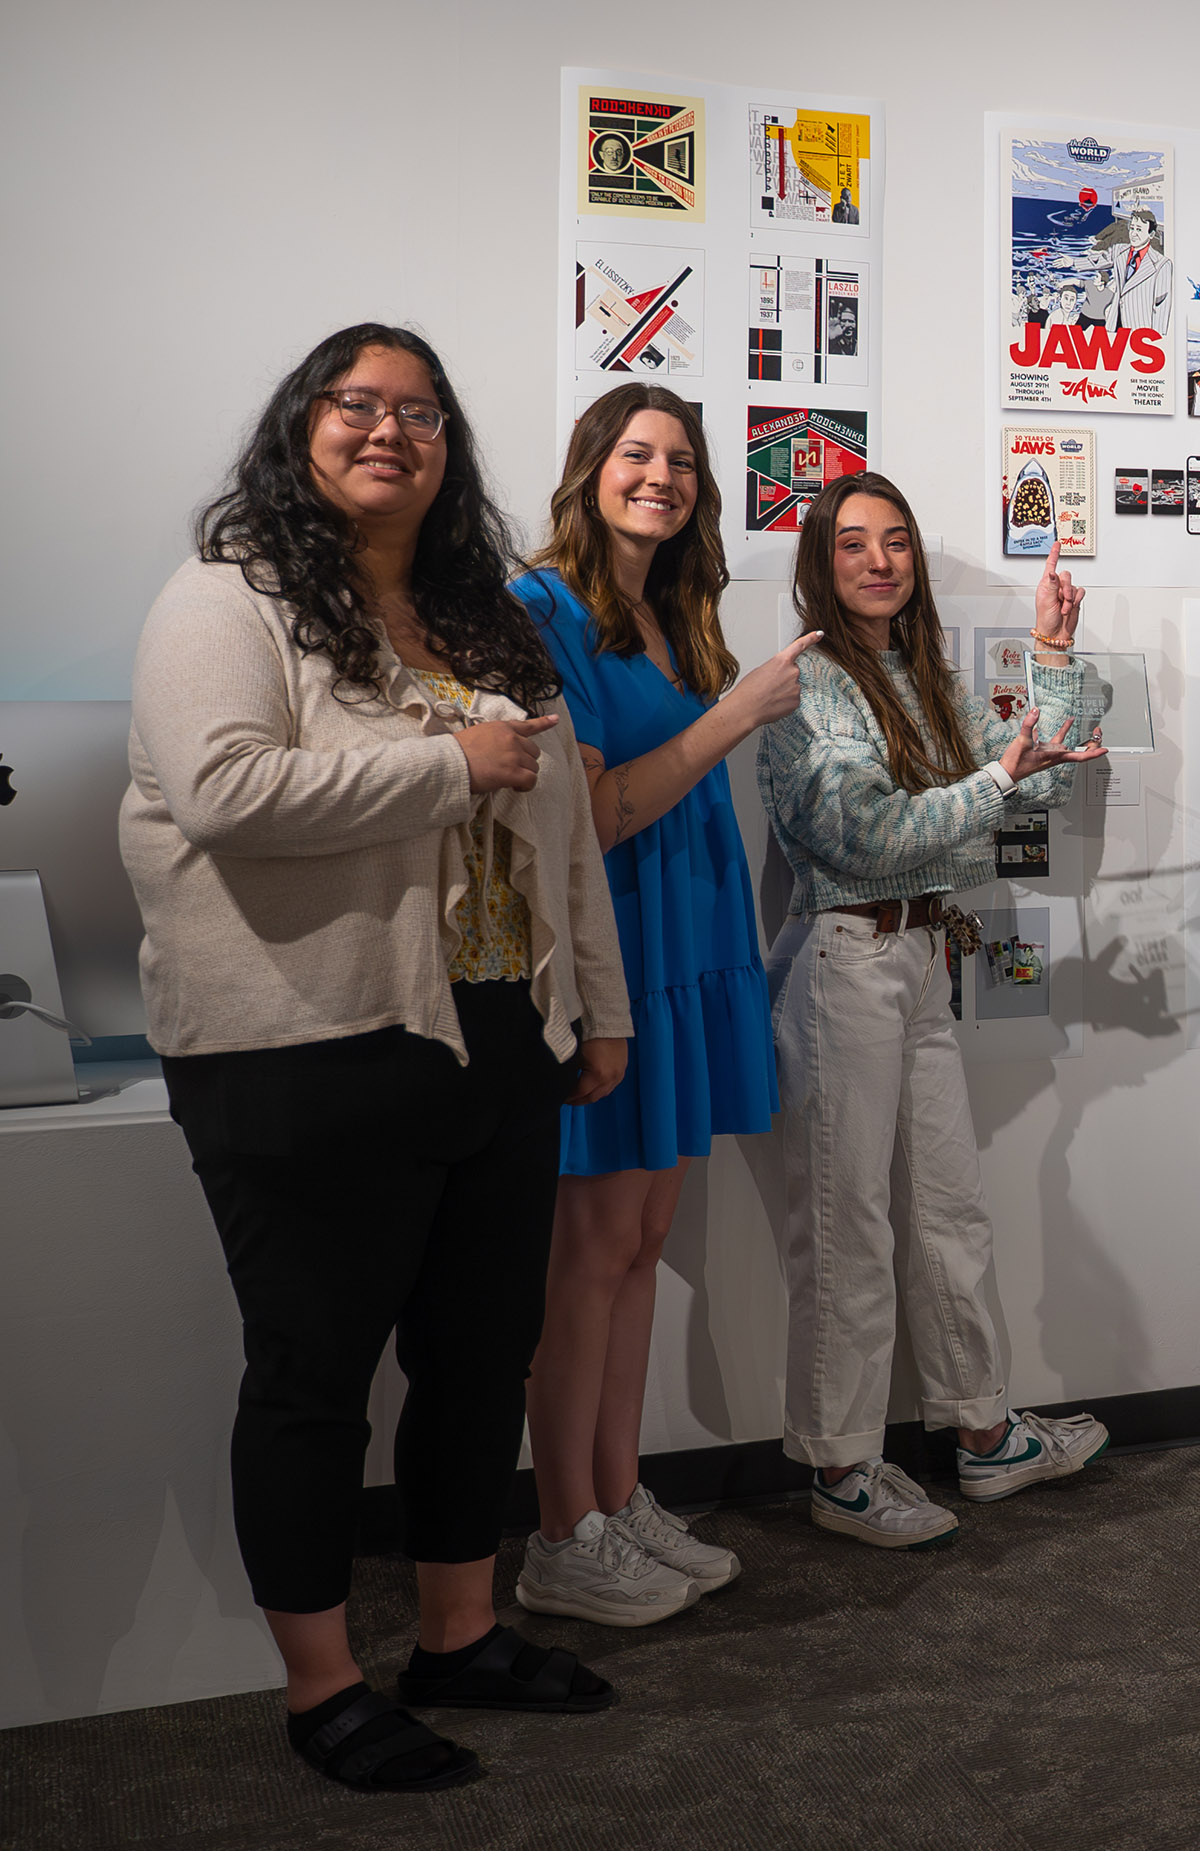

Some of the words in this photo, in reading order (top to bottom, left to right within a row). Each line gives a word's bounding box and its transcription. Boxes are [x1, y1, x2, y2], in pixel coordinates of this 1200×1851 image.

[1070, 146, 1107, 158] WORLD
[828, 282, 859, 292] LASZLO
[1009, 322, 1166, 374] JAWS
[1010, 372, 1050, 382] SHOWING
[1010, 381, 1035, 389] AUGUST
[1015, 388, 1045, 396] THROUGH
[1008, 394, 1040, 402] SEPTEMBER
[1011, 441, 1056, 456] JAWS
